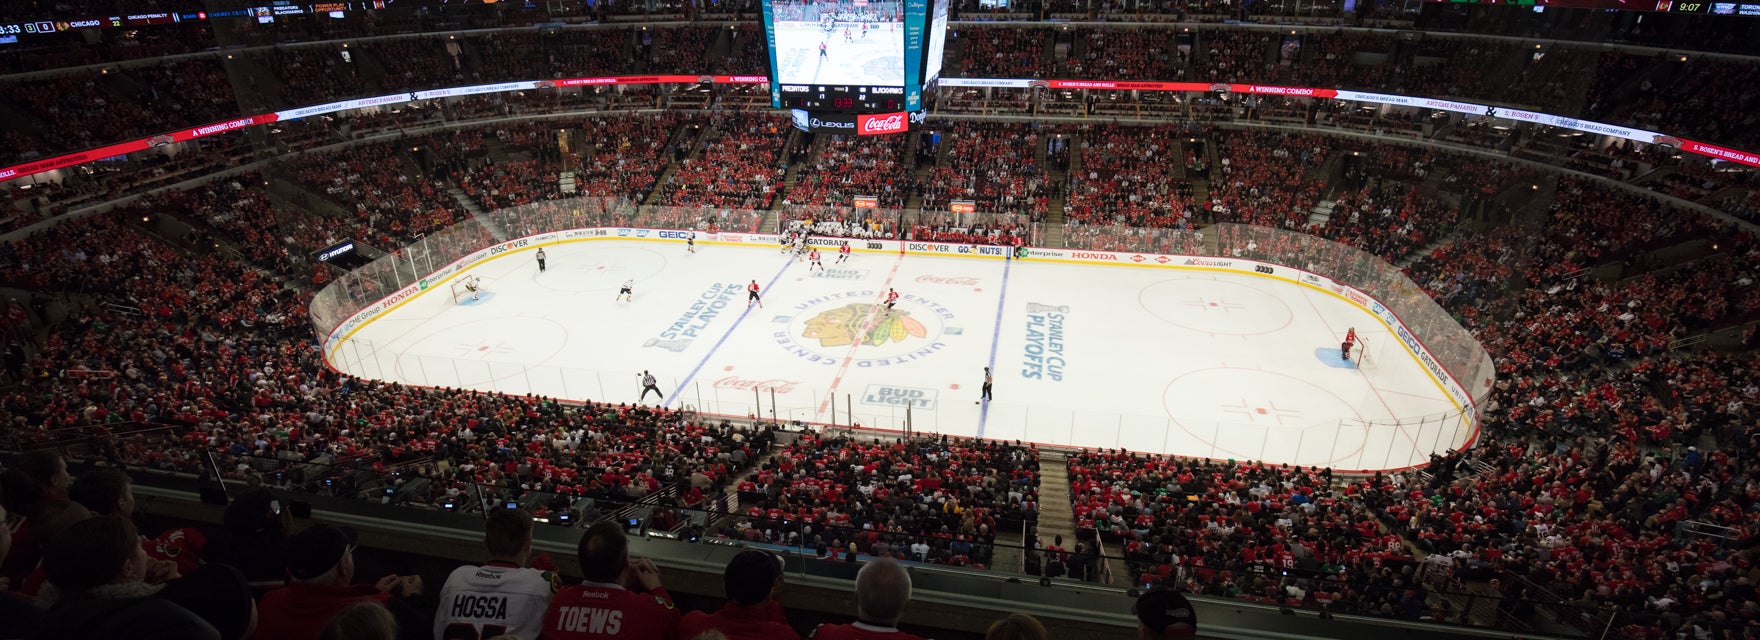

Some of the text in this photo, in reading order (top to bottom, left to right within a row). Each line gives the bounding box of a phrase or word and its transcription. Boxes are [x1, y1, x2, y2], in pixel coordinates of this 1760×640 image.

[1680, 3, 1700, 11] 9:07
[70, 20, 100, 28] CHICAGO
[409, 91, 418, 100] &
[1255, 86, 1285, 94] WINNING
[1286, 88, 1313, 96] COMBO!
[887, 100, 894, 109] 0
[1426, 100, 1450, 108] ARTEMI
[1486, 105, 1497, 117] &
[192, 118, 254, 137] A WINNING COMBO!
[864, 115, 903, 132] Coca-Cola
[1584, 123, 1602, 132] BREAD
[1602, 126, 1631, 136] COMPANY
[1699, 146, 1723, 156] ROSEN'S
[1724, 151, 1744, 160] BREAD
[1744, 156, 1758, 164] AND
[329, 244, 353, 258] HYUNDAI
[491, 239, 528, 255] DISCOVER
[910, 243, 949, 252] DISCOVER
[980, 246, 1002, 255] NUTS!
[1072, 252, 1118, 260] HONDA
[1213, 259, 1232, 268] LIGHT
[915, 275, 980, 285] Coca-Cola
[383, 286, 419, 308] HONDA
[794, 290, 954, 320] UNITED ENTER
[348, 306, 380, 328] CME Group
[660, 283, 723, 339] STANLEY CUP
[681, 284, 743, 338] PLAYOFFS
[1022, 315, 1045, 380] PLAYOFFS
[1046, 312, 1066, 382] STANLEY CUP
[1398, 325, 1420, 355] GEICO
[774, 332, 946, 367] CENTER UNITED
[1421, 352, 1448, 385] GATORADE
[713, 376, 802, 394] Coca-Cola
[878, 387, 922, 397] BUD
[866, 394, 932, 407] LIGHT
[1282, 559, 1294, 569] 19
[476, 571, 501, 580] Reebok
[582, 590, 608, 599] Reebok
[451, 595, 507, 619] HOSSA
[557, 606, 622, 635] TOEWS
